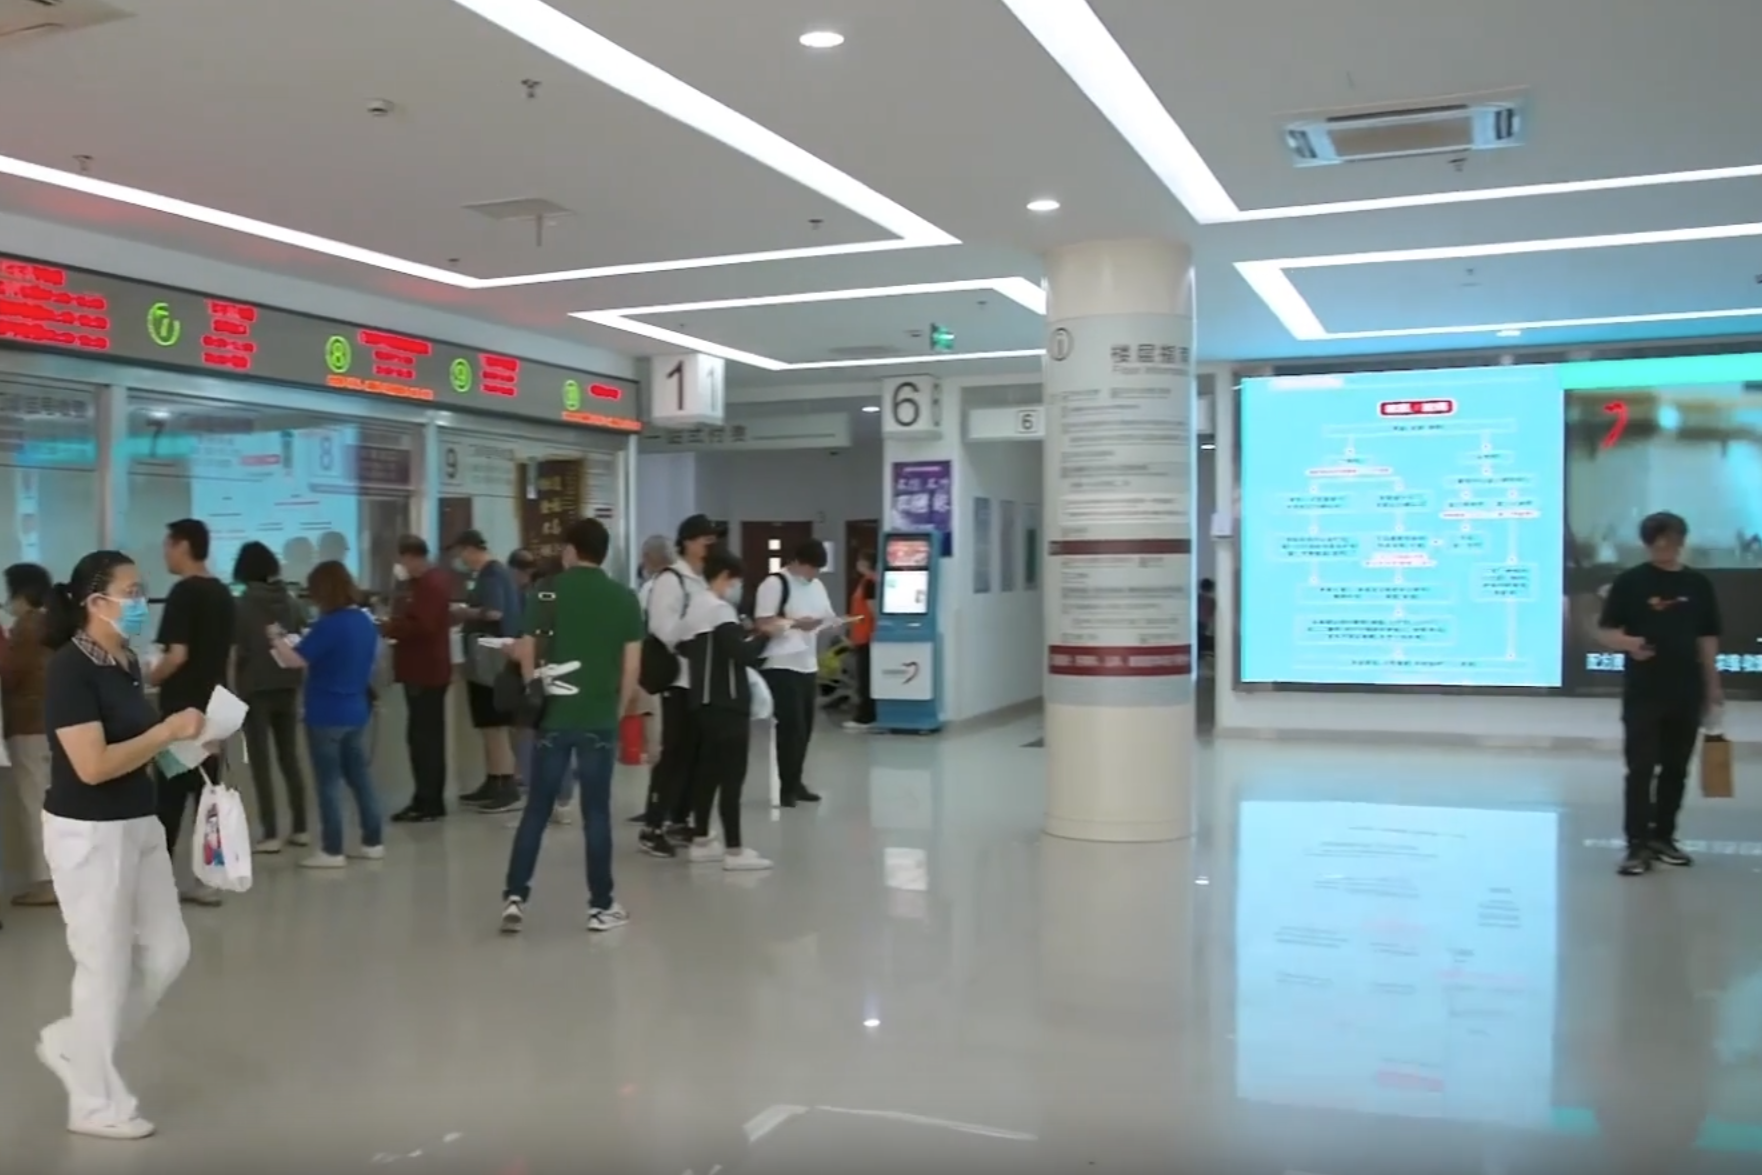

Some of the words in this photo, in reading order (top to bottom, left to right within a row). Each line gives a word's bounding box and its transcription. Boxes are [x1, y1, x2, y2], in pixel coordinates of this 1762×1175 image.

[665, 359, 685, 411] 1
[891, 381, 921, 427] 6
[1020, 413, 1035, 431] 6
[319, 435, 335, 472] 8
